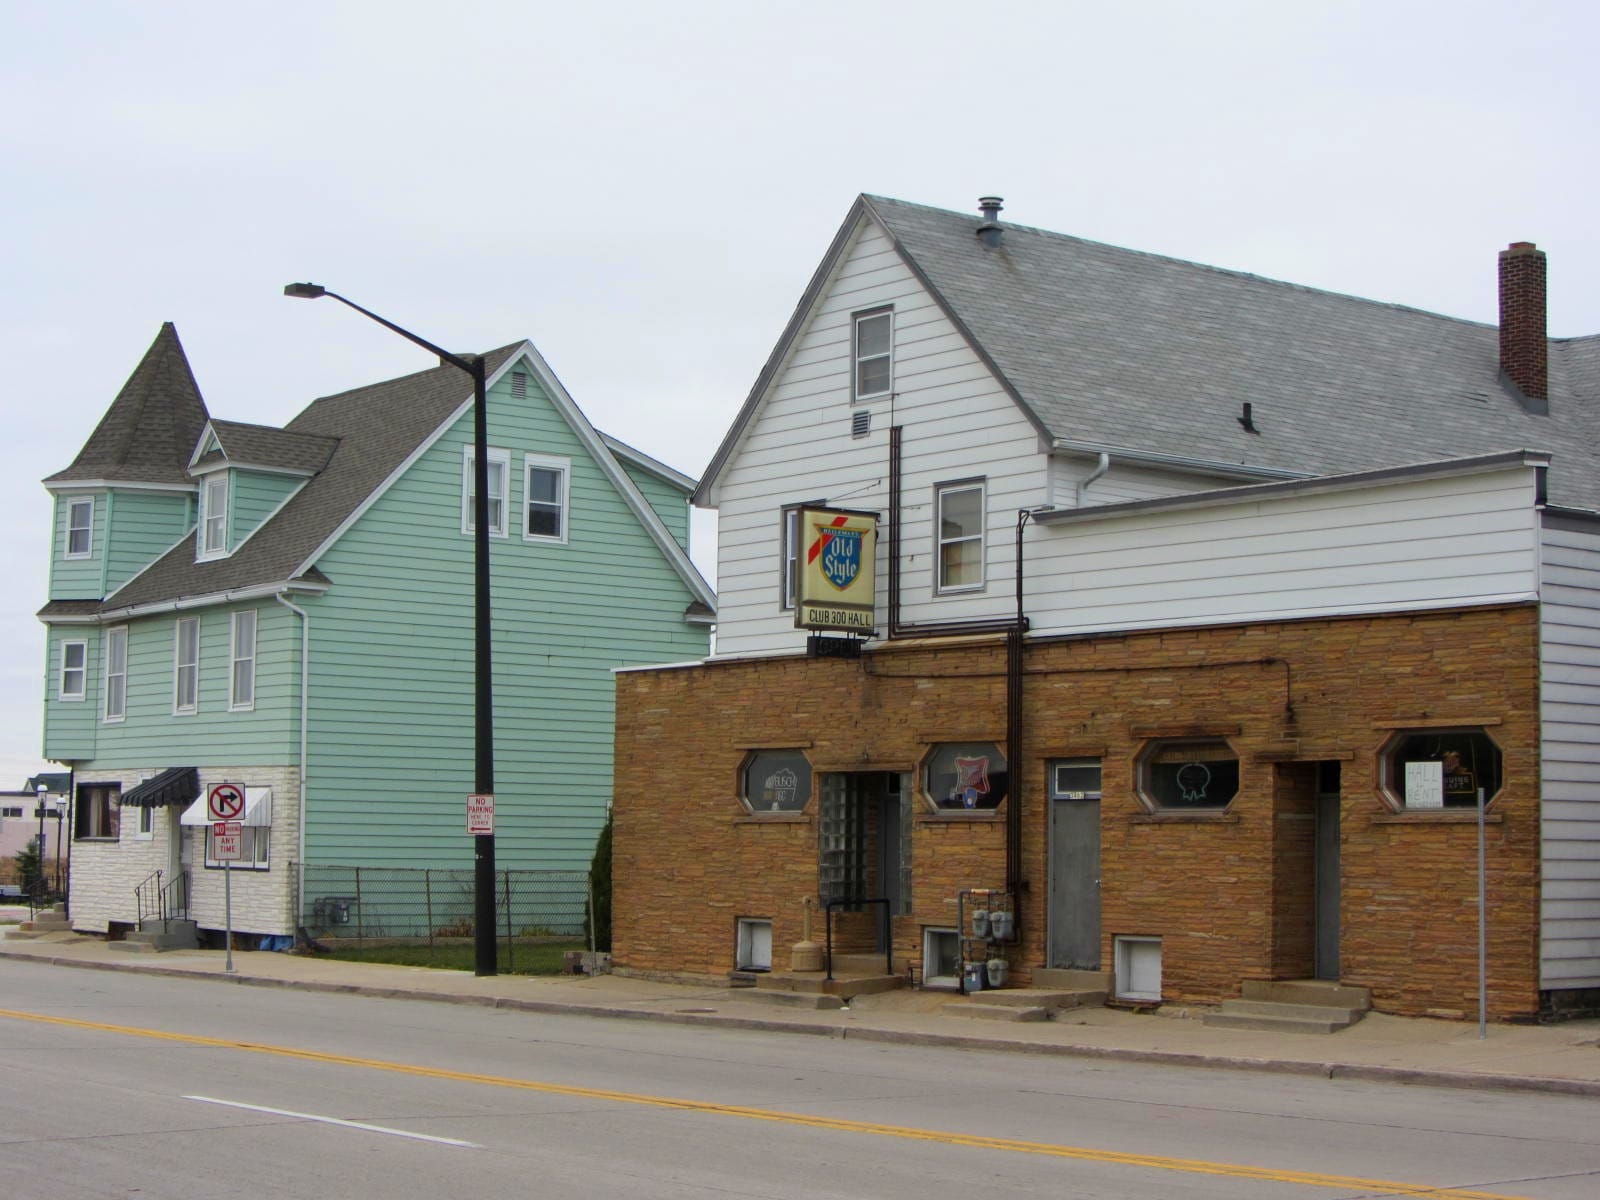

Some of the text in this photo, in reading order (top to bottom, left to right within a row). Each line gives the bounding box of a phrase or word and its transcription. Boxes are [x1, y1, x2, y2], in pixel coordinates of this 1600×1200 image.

[831, 537, 853, 557] Old
[825, 554, 857, 584] Style
[809, 609, 871, 626] CLUB 300 HALL
[475, 797, 486, 805] NO
[468, 806, 493, 814] PARKING
[215, 824, 225, 834] NO
